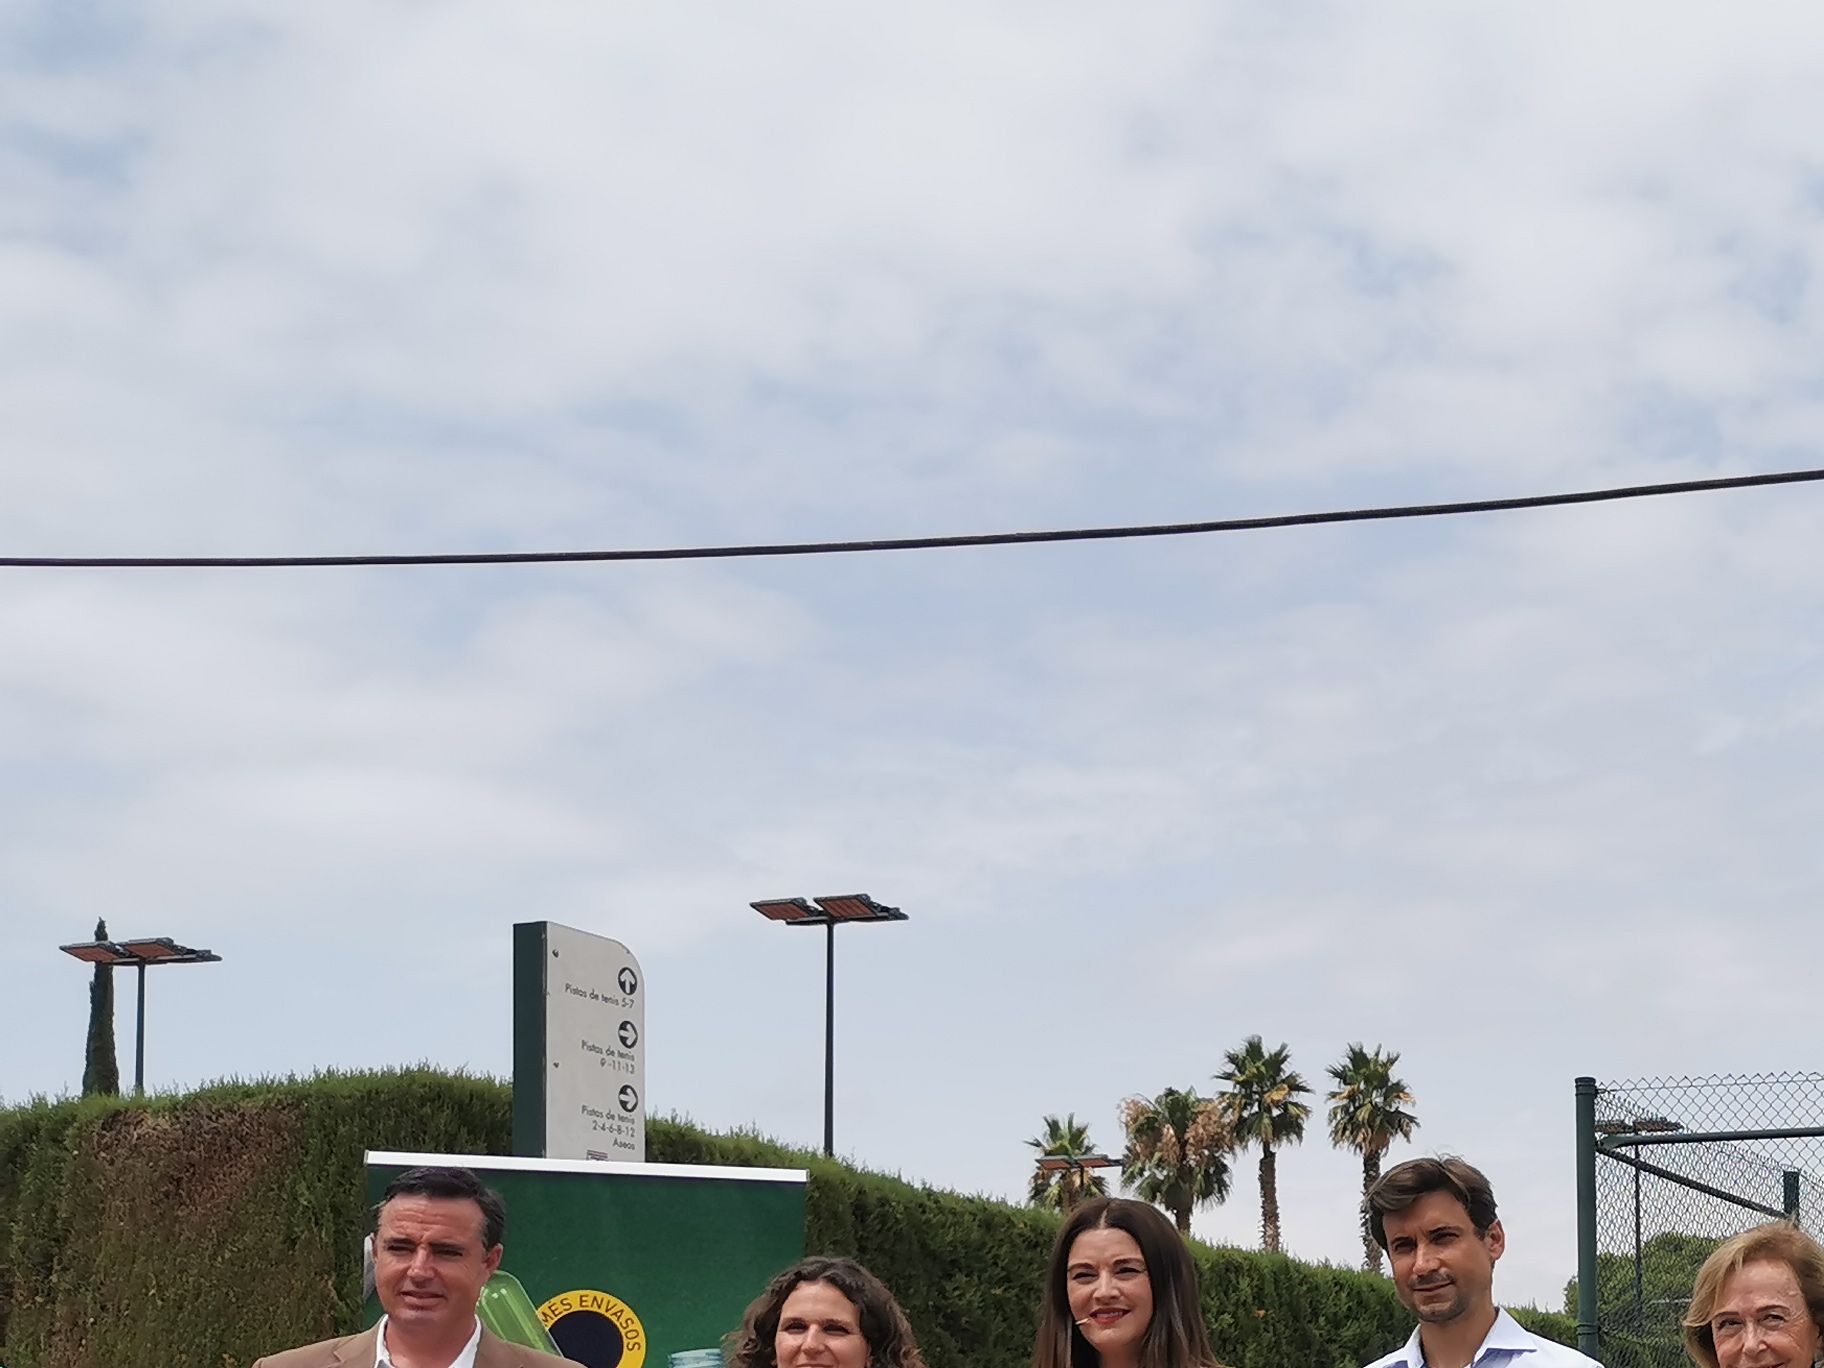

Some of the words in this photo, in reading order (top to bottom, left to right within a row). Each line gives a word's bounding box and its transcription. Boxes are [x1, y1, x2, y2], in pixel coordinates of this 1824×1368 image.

[565, 983, 587, 998] Pistas
[589, 988, 599, 1000] de
[601, 994, 619, 1006] tenis
[581, 1040, 603, 1055] Pistas
[605, 1046, 615, 1057] de
[617, 1050, 635, 1061] tenis
[581, 1104, 604, 1118] Pistas
[605, 1108, 616, 1121] de
[617, 1113, 635, 1125] tenis
[612, 1137, 635, 1150] Aseos
[579, 1294, 641, 1352] ENVASOS
